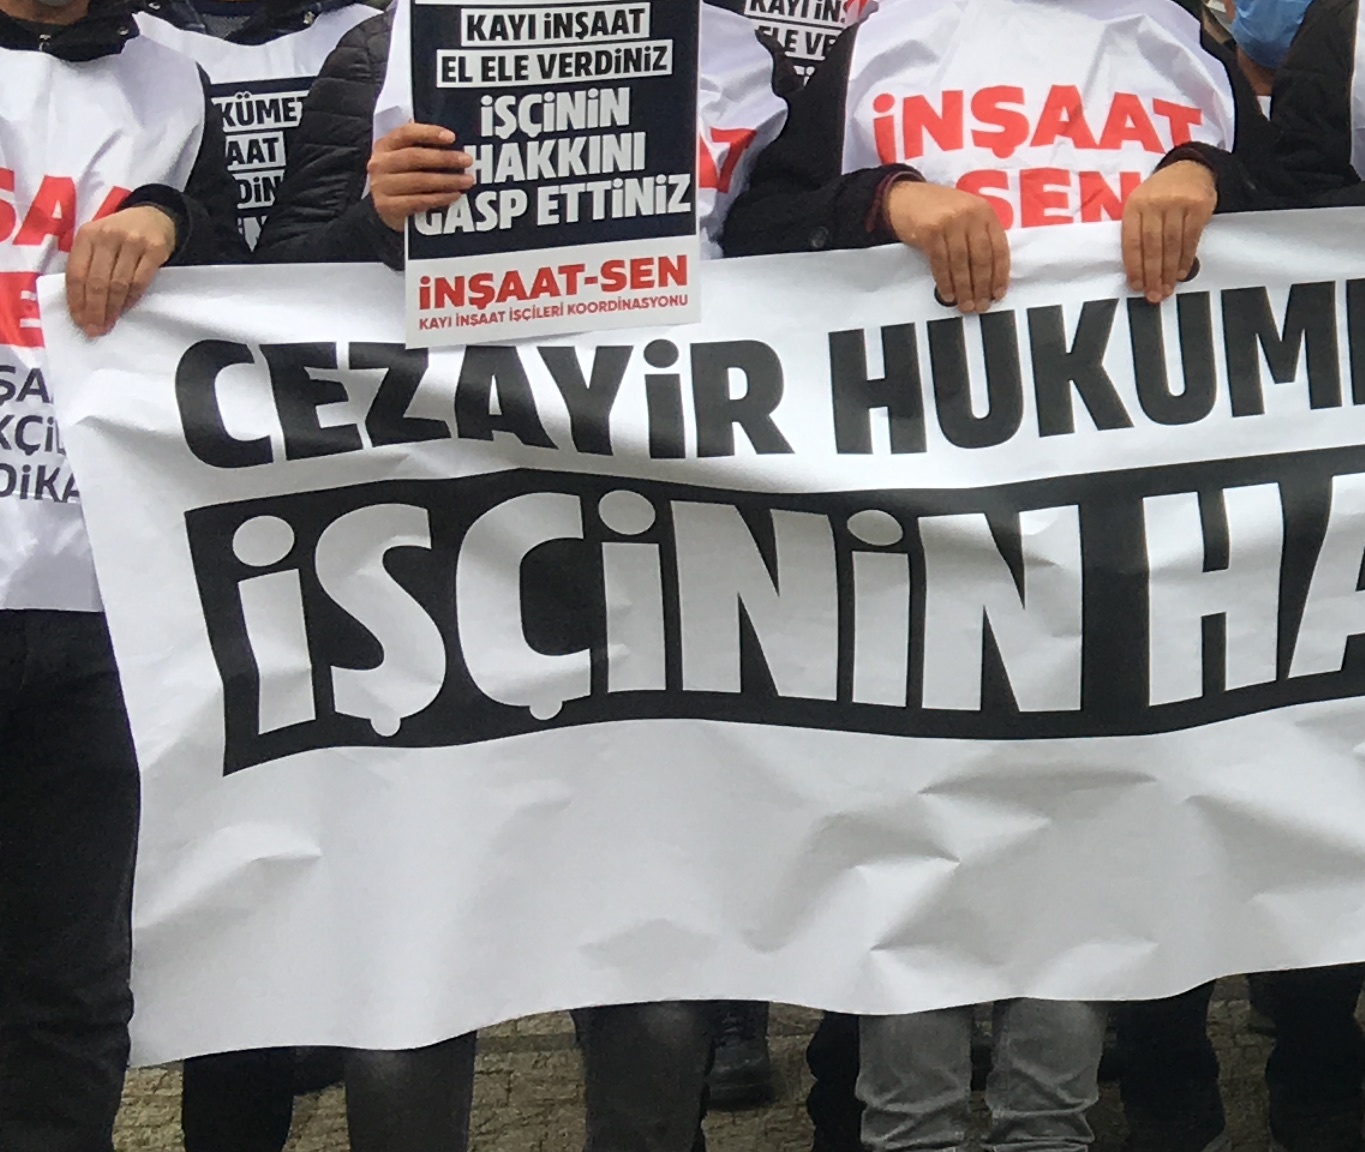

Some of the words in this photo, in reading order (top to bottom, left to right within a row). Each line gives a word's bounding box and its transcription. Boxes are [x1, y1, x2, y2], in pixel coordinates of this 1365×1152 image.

[466, 13, 536, 42] KAYI
[441, 55, 473, 83] EL
[481, 54, 529, 81] ELE
[463, 131, 646, 185] HAKKINI
[414, 190, 528, 236] GASP
[956, 168, 1140, 230] SEN
[419, 317, 453, 331] KAYI
